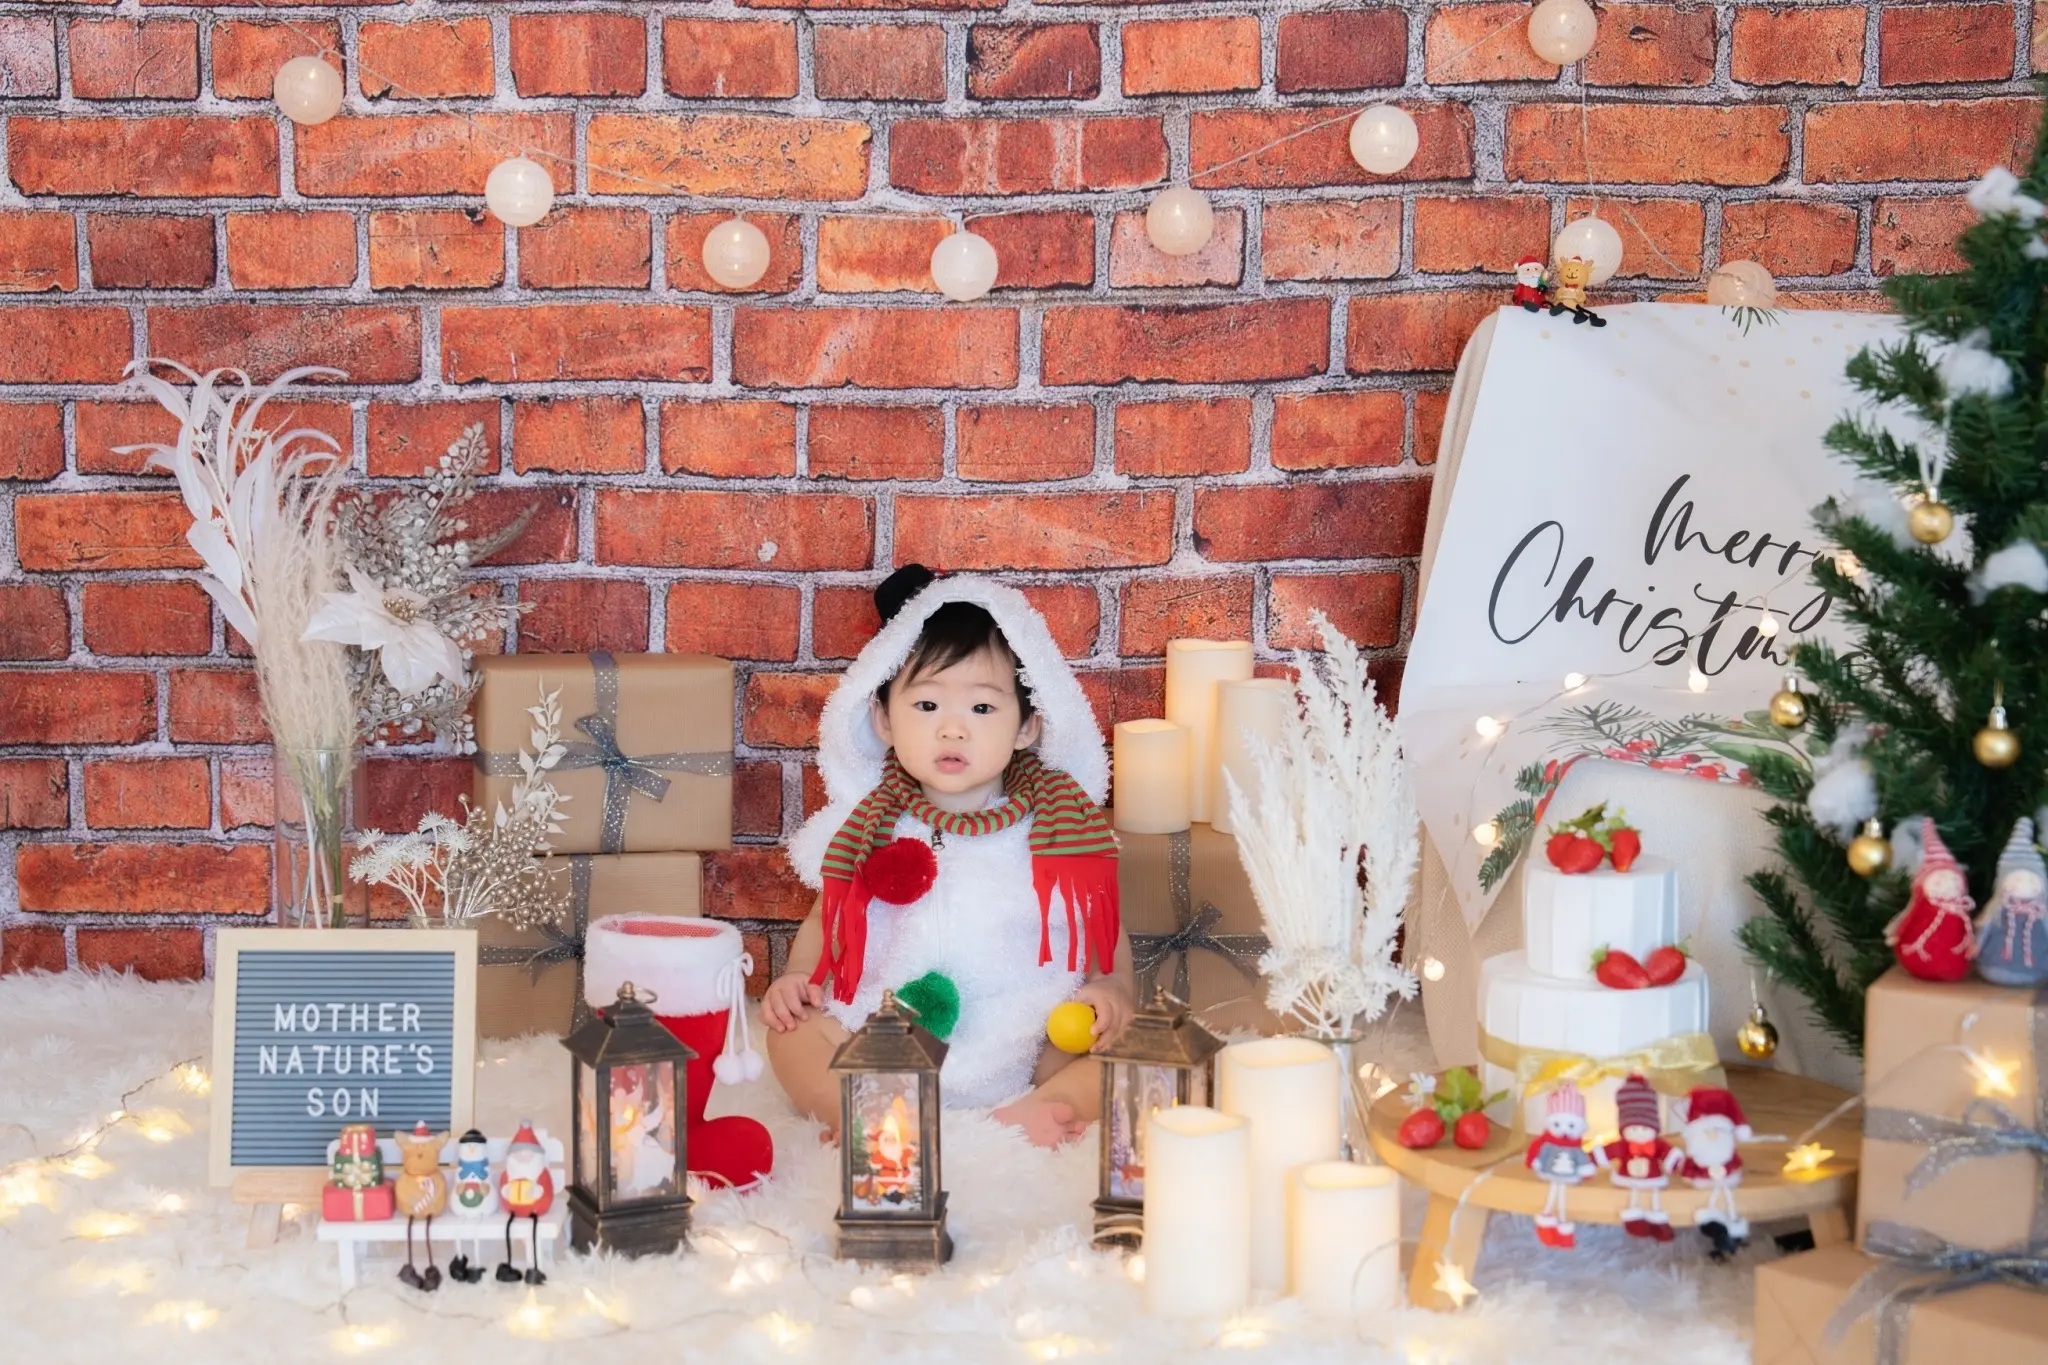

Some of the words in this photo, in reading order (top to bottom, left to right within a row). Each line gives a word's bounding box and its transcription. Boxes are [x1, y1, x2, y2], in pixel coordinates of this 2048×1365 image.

[274, 1002, 421, 1033] MOTHER
[258, 1042, 435, 1076] NATURE'S
[306, 1087, 380, 1118] SON
